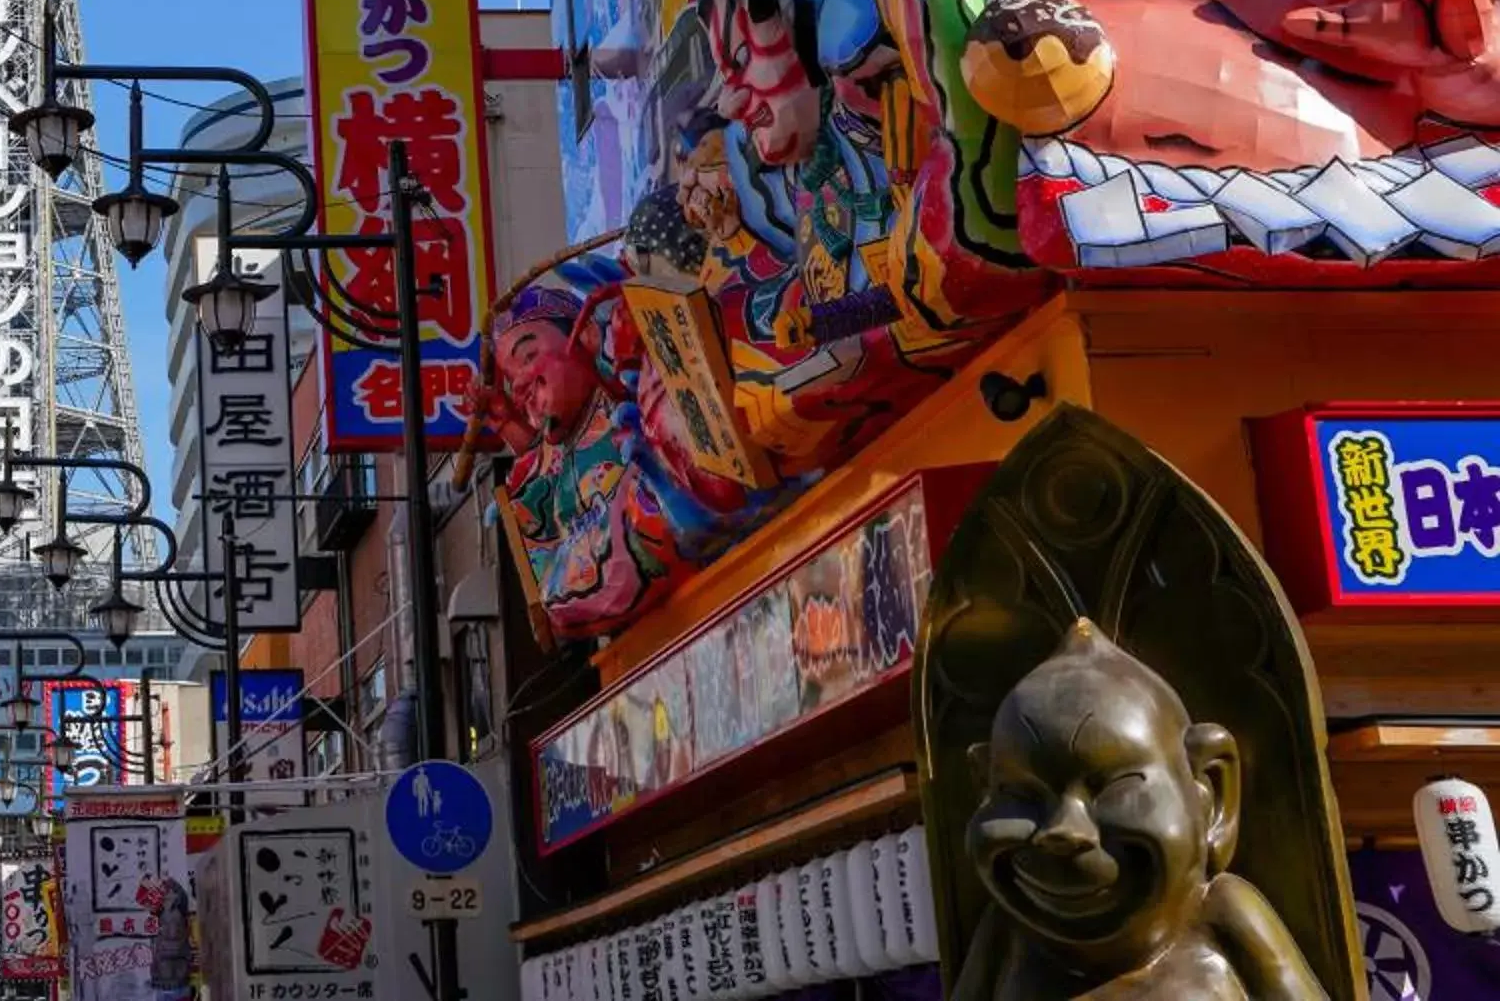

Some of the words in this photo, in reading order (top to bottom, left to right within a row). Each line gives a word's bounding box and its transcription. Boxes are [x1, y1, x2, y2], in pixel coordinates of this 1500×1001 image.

[207, 255, 290, 601] 田屋酒店
[1336, 436, 1405, 579] 新世界
[1445, 817, 1494, 913] 串かつ
